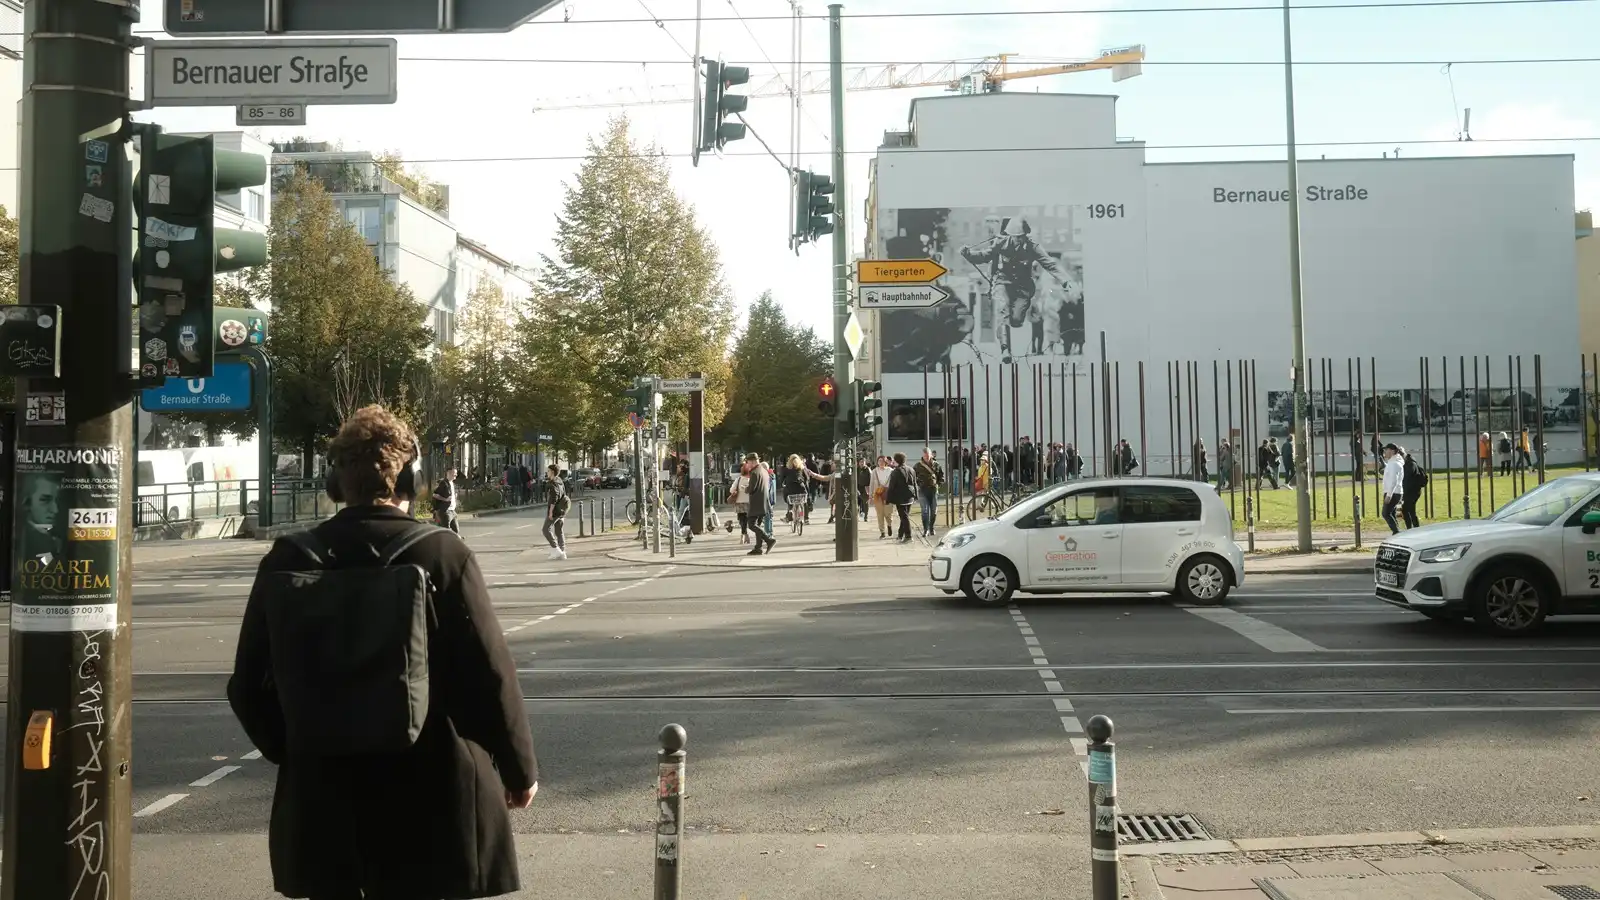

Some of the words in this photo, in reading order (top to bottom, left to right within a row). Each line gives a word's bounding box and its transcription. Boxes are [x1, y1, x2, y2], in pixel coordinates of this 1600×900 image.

[172, 57, 283, 84] Bernauer
[289, 56, 369, 90] Straße
[249, 108, 264, 118] 85
[279, 108, 294, 118] 86
[1213, 187, 1299, 203] Bernaue
[1306, 185, 1369, 201] Straße
[1086, 203, 1125, 219] 1961
[874, 267, 925, 278] Tiergarten
[881, 291, 932, 302] Hauptbahnhof
[160, 395, 200, 404] Bernauer
[203, 394, 231, 404] Straße
[75, 529, 87, 538] SO
[1045, 551, 1097, 562] Generation
[20, 574, 111, 593] REQUIEM
[81, 606, 93, 614] 00
[94, 606, 104, 614] 70
